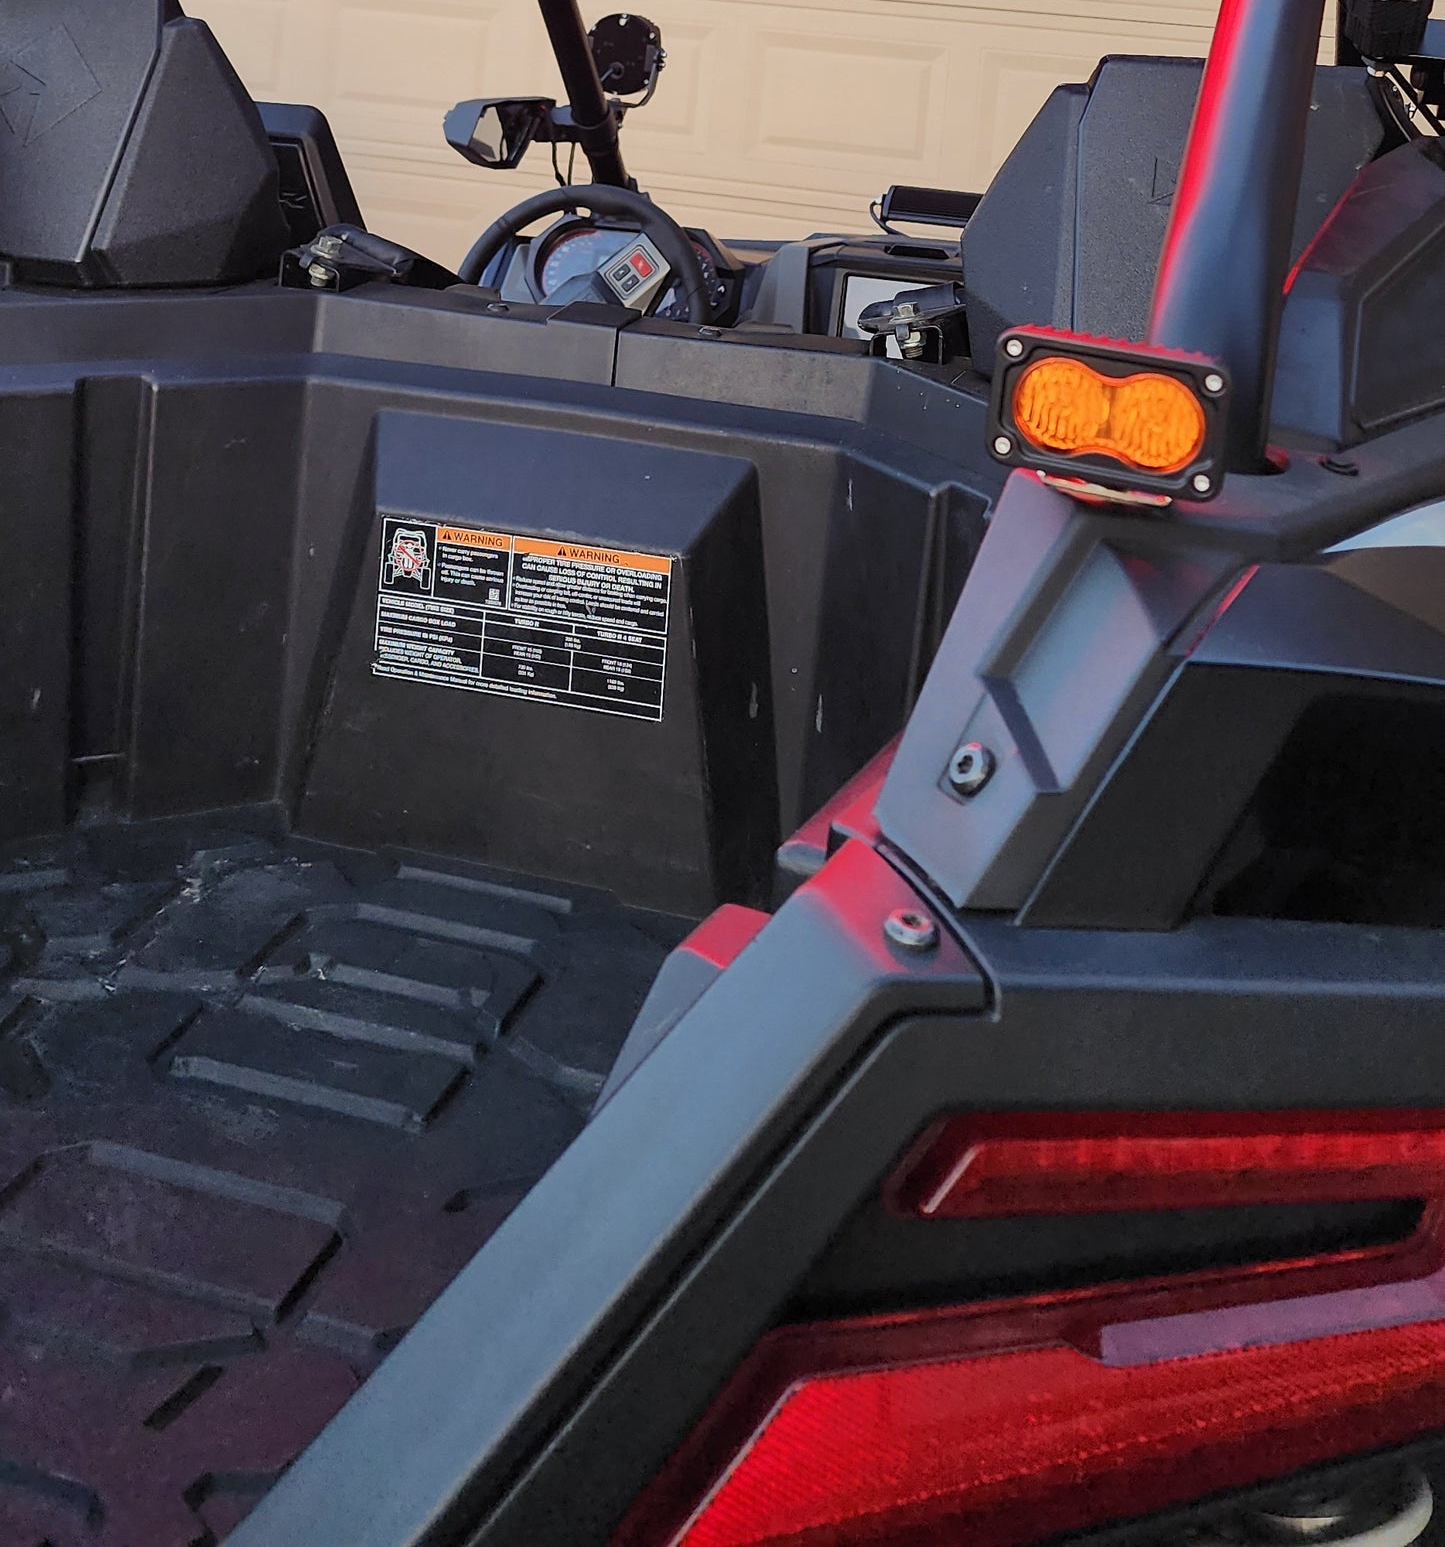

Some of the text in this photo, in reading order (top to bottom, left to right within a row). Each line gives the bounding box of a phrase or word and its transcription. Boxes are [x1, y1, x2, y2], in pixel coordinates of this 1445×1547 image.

[454, 533, 503, 546] WARNING
[570, 548, 620, 564] WARNING
[537, 565, 558, 574] CAUSE
[559, 568, 575, 576] LOSS
[586, 572, 617, 582] CONTROL
[618, 577, 653, 588] RESULTING
[557, 560, 570, 568] TIRE
[616, 569, 662, 581] OVERLOADING
[549, 574, 576, 584] SERIOUS
